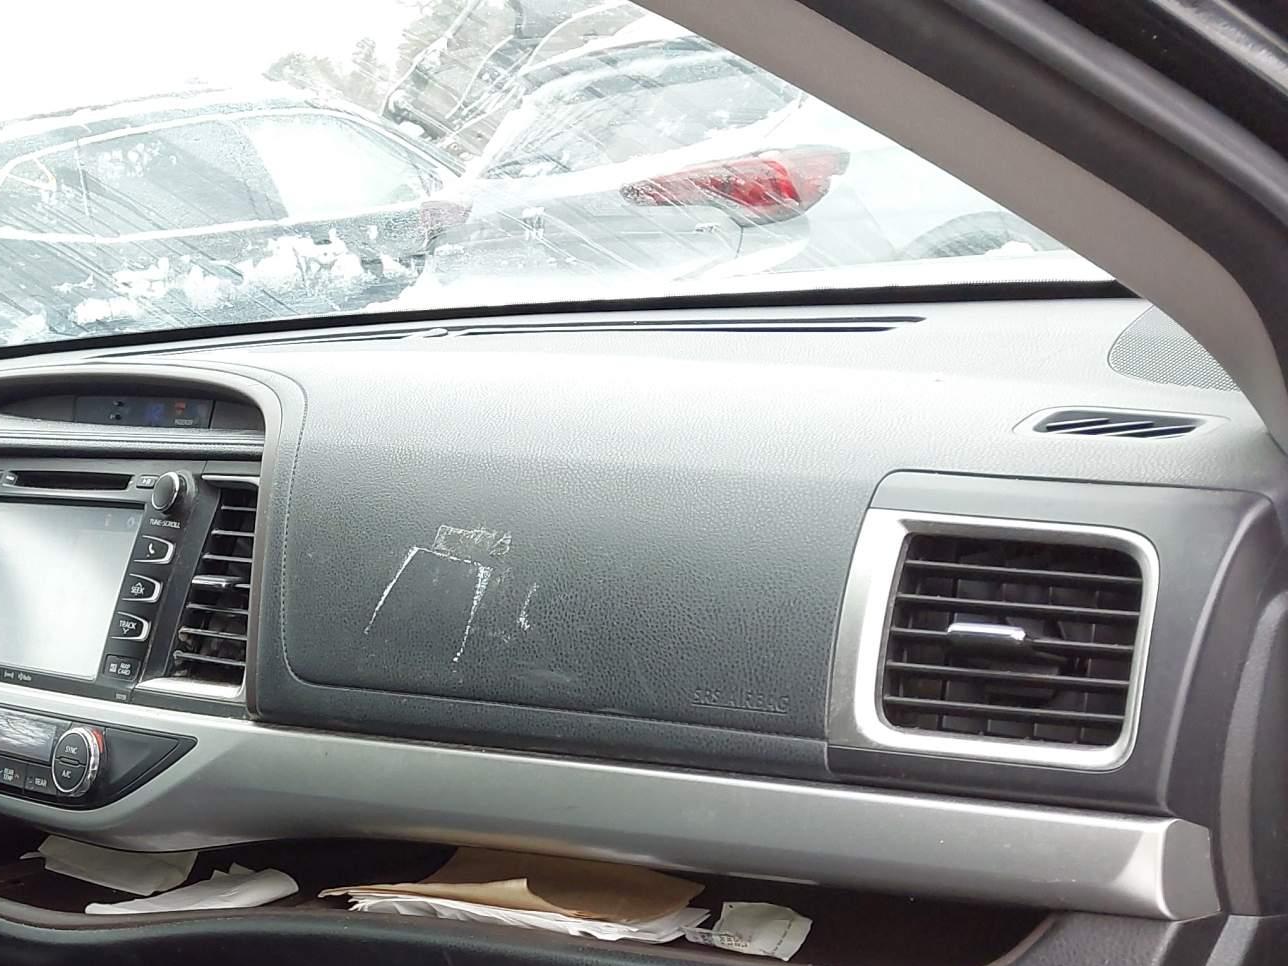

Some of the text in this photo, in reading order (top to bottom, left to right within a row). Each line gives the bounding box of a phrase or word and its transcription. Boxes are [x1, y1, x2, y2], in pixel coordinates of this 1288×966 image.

[131, 585, 145, 595] SEEK
[119, 620, 137, 630] TRACK
[64, 745, 78, 755] SYNC
[34, 778, 48, 787] REAR
